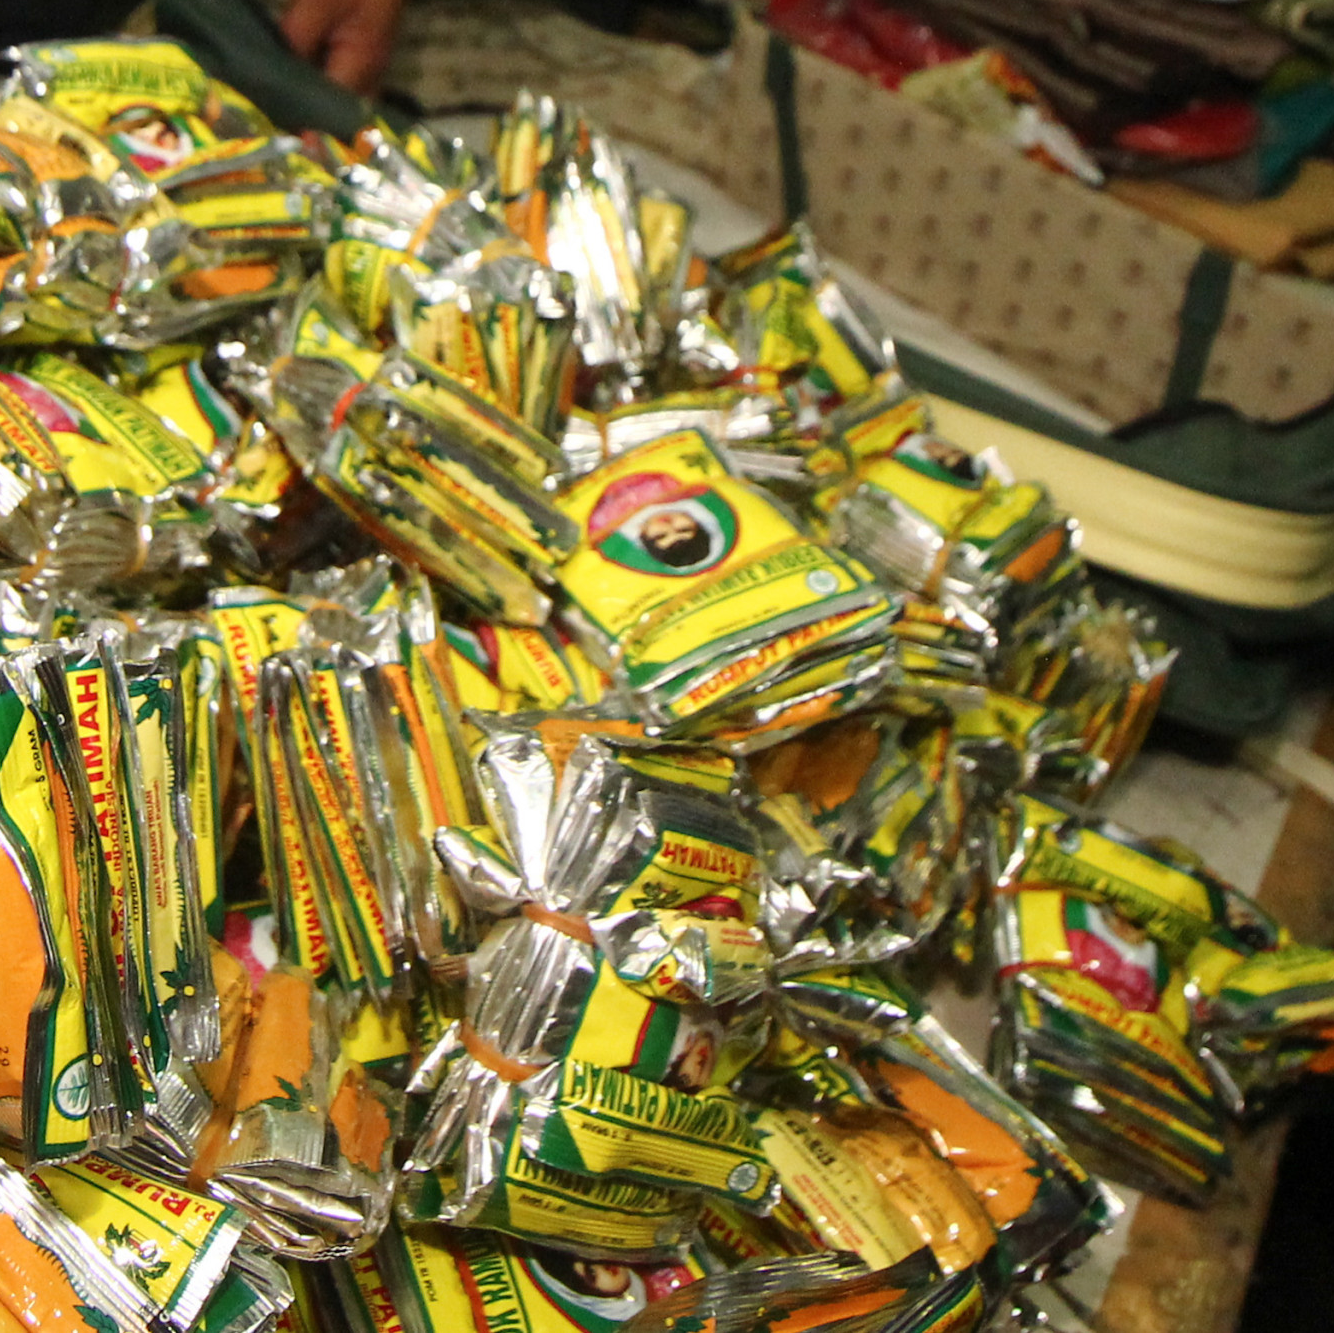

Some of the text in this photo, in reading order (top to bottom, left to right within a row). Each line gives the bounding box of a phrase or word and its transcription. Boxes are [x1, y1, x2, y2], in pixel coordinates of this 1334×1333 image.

[26, 729, 44, 773] GRAM
[145, 790, 163, 907] AWAS BARANG TIRUAN
